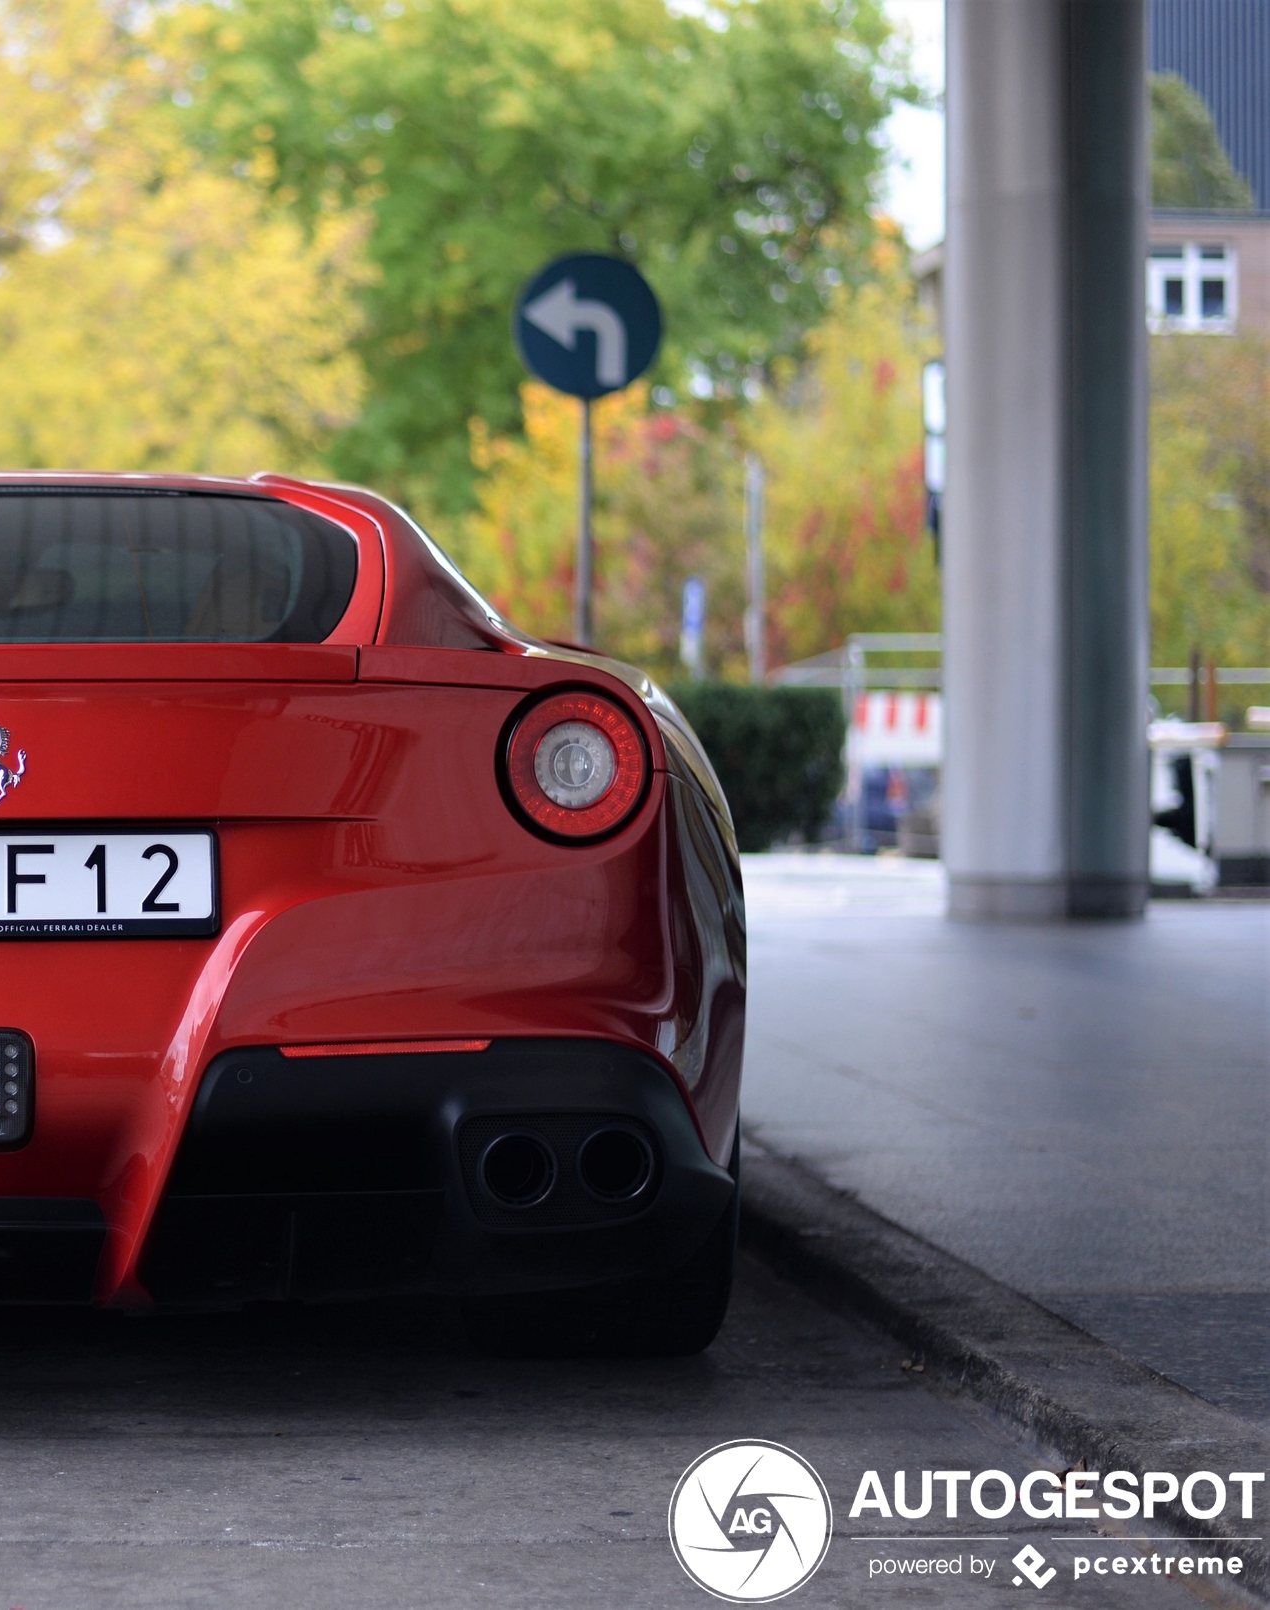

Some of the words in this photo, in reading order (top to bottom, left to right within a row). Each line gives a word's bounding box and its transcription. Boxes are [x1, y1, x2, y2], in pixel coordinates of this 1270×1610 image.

[7, 842, 180, 914] F12
[43, 924, 84, 932] FERRARI
[86, 923, 124, 932] DEALER
